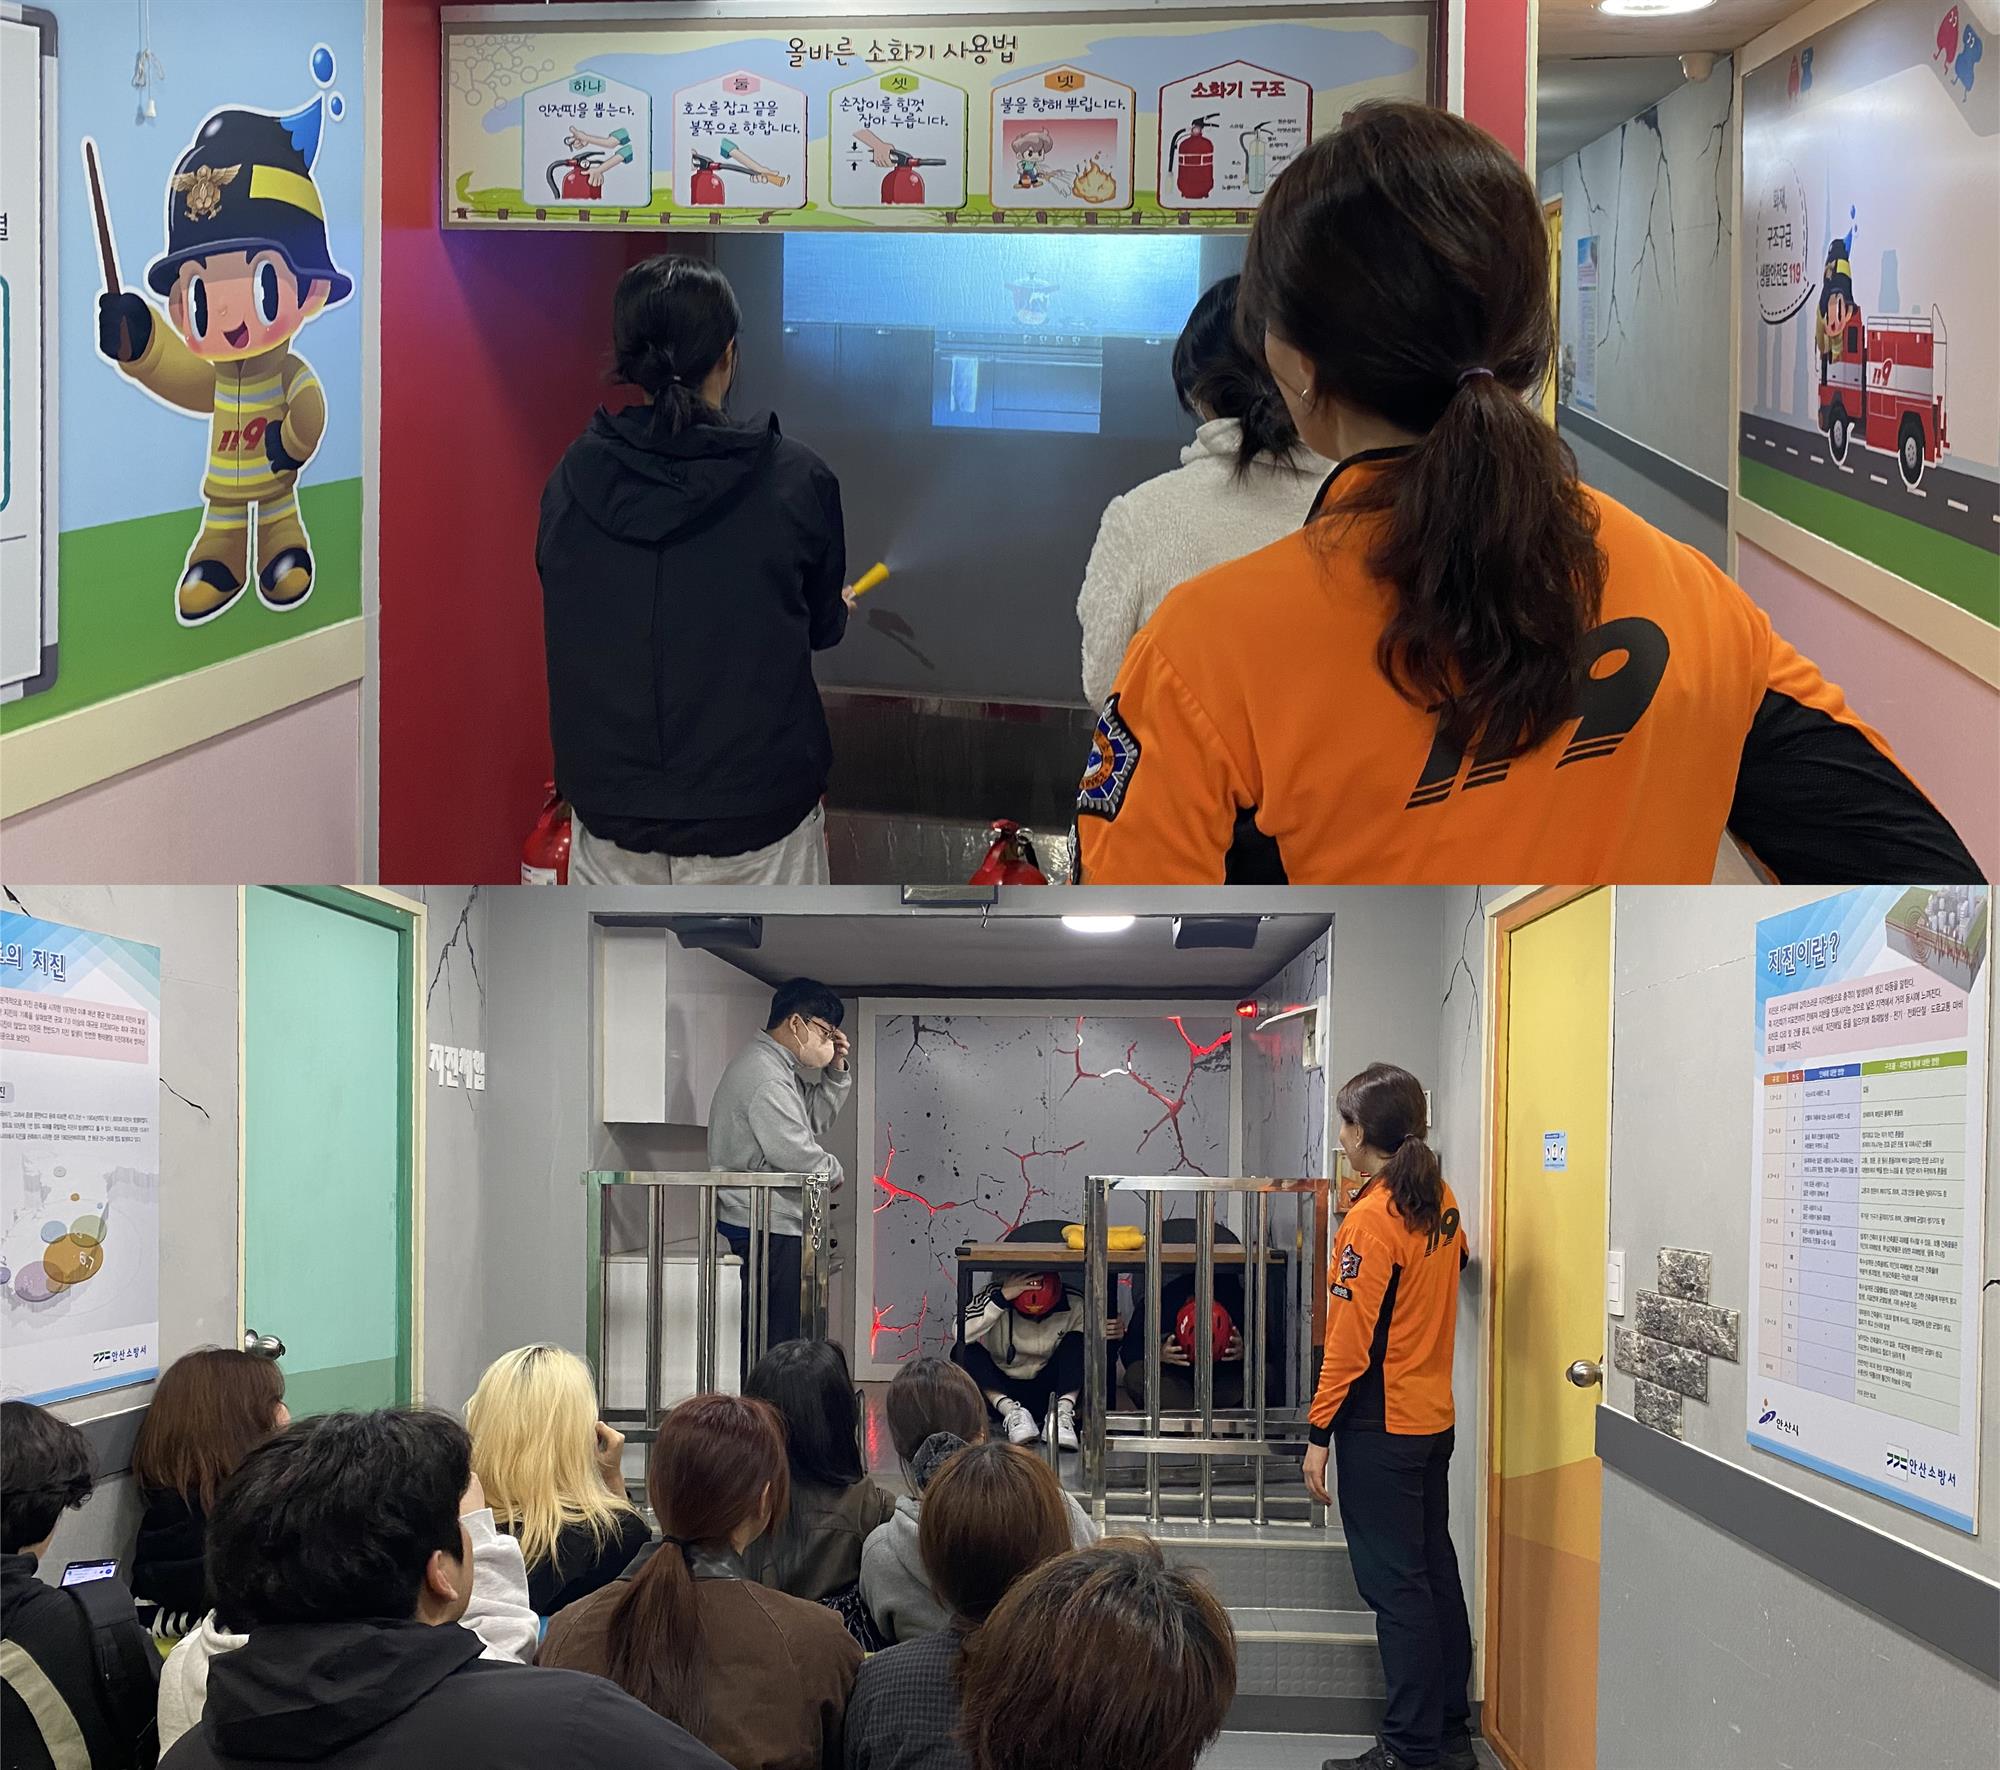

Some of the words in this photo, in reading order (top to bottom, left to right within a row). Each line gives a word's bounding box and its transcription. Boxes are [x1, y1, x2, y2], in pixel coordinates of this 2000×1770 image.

[786, 36, 855, 67] 올바른
[864, 38, 934, 63] 소화기
[943, 33, 1018, 64] 사용법
[573, 80, 602, 93] 하나
[733, 78, 750, 91] 둘
[891, 76, 908, 91] 셋
[1056, 75, 1074, 89] 넷
[1190, 80, 1244, 99] 소화기
[1249, 80, 1287, 97] 구조
[538, 103, 589, 118] 안전핀을
[593, 102, 636, 118] 뽑는다.
[682, 101, 721, 117] 호스를
[723, 101, 750, 117] 잡고
[753, 100, 779, 117] 끝을
[839, 96, 893, 113] 손잡이를
[896, 97, 925, 113] 힘껏
[1000, 96, 1028, 114] 불을
[1032, 97, 1063, 113] 향해
[1065, 95, 1127, 113] 뿌립니다.
[689, 120, 740, 136] 불쪽으로
[743, 120, 801, 136] 향합니다.
[858, 113, 887, 128] 잡아
[890, 112, 949, 128] 누릅니다.
[1872, 358, 1892, 386] 119
[217, 416, 268, 452] 119
[1768, 931, 1840, 976] 지진이란?
[32, 948, 66, 982] 지진
[1776, 1418, 1799, 1437] 안산시
[1909, 1458, 1956, 1487] 안산소방서
